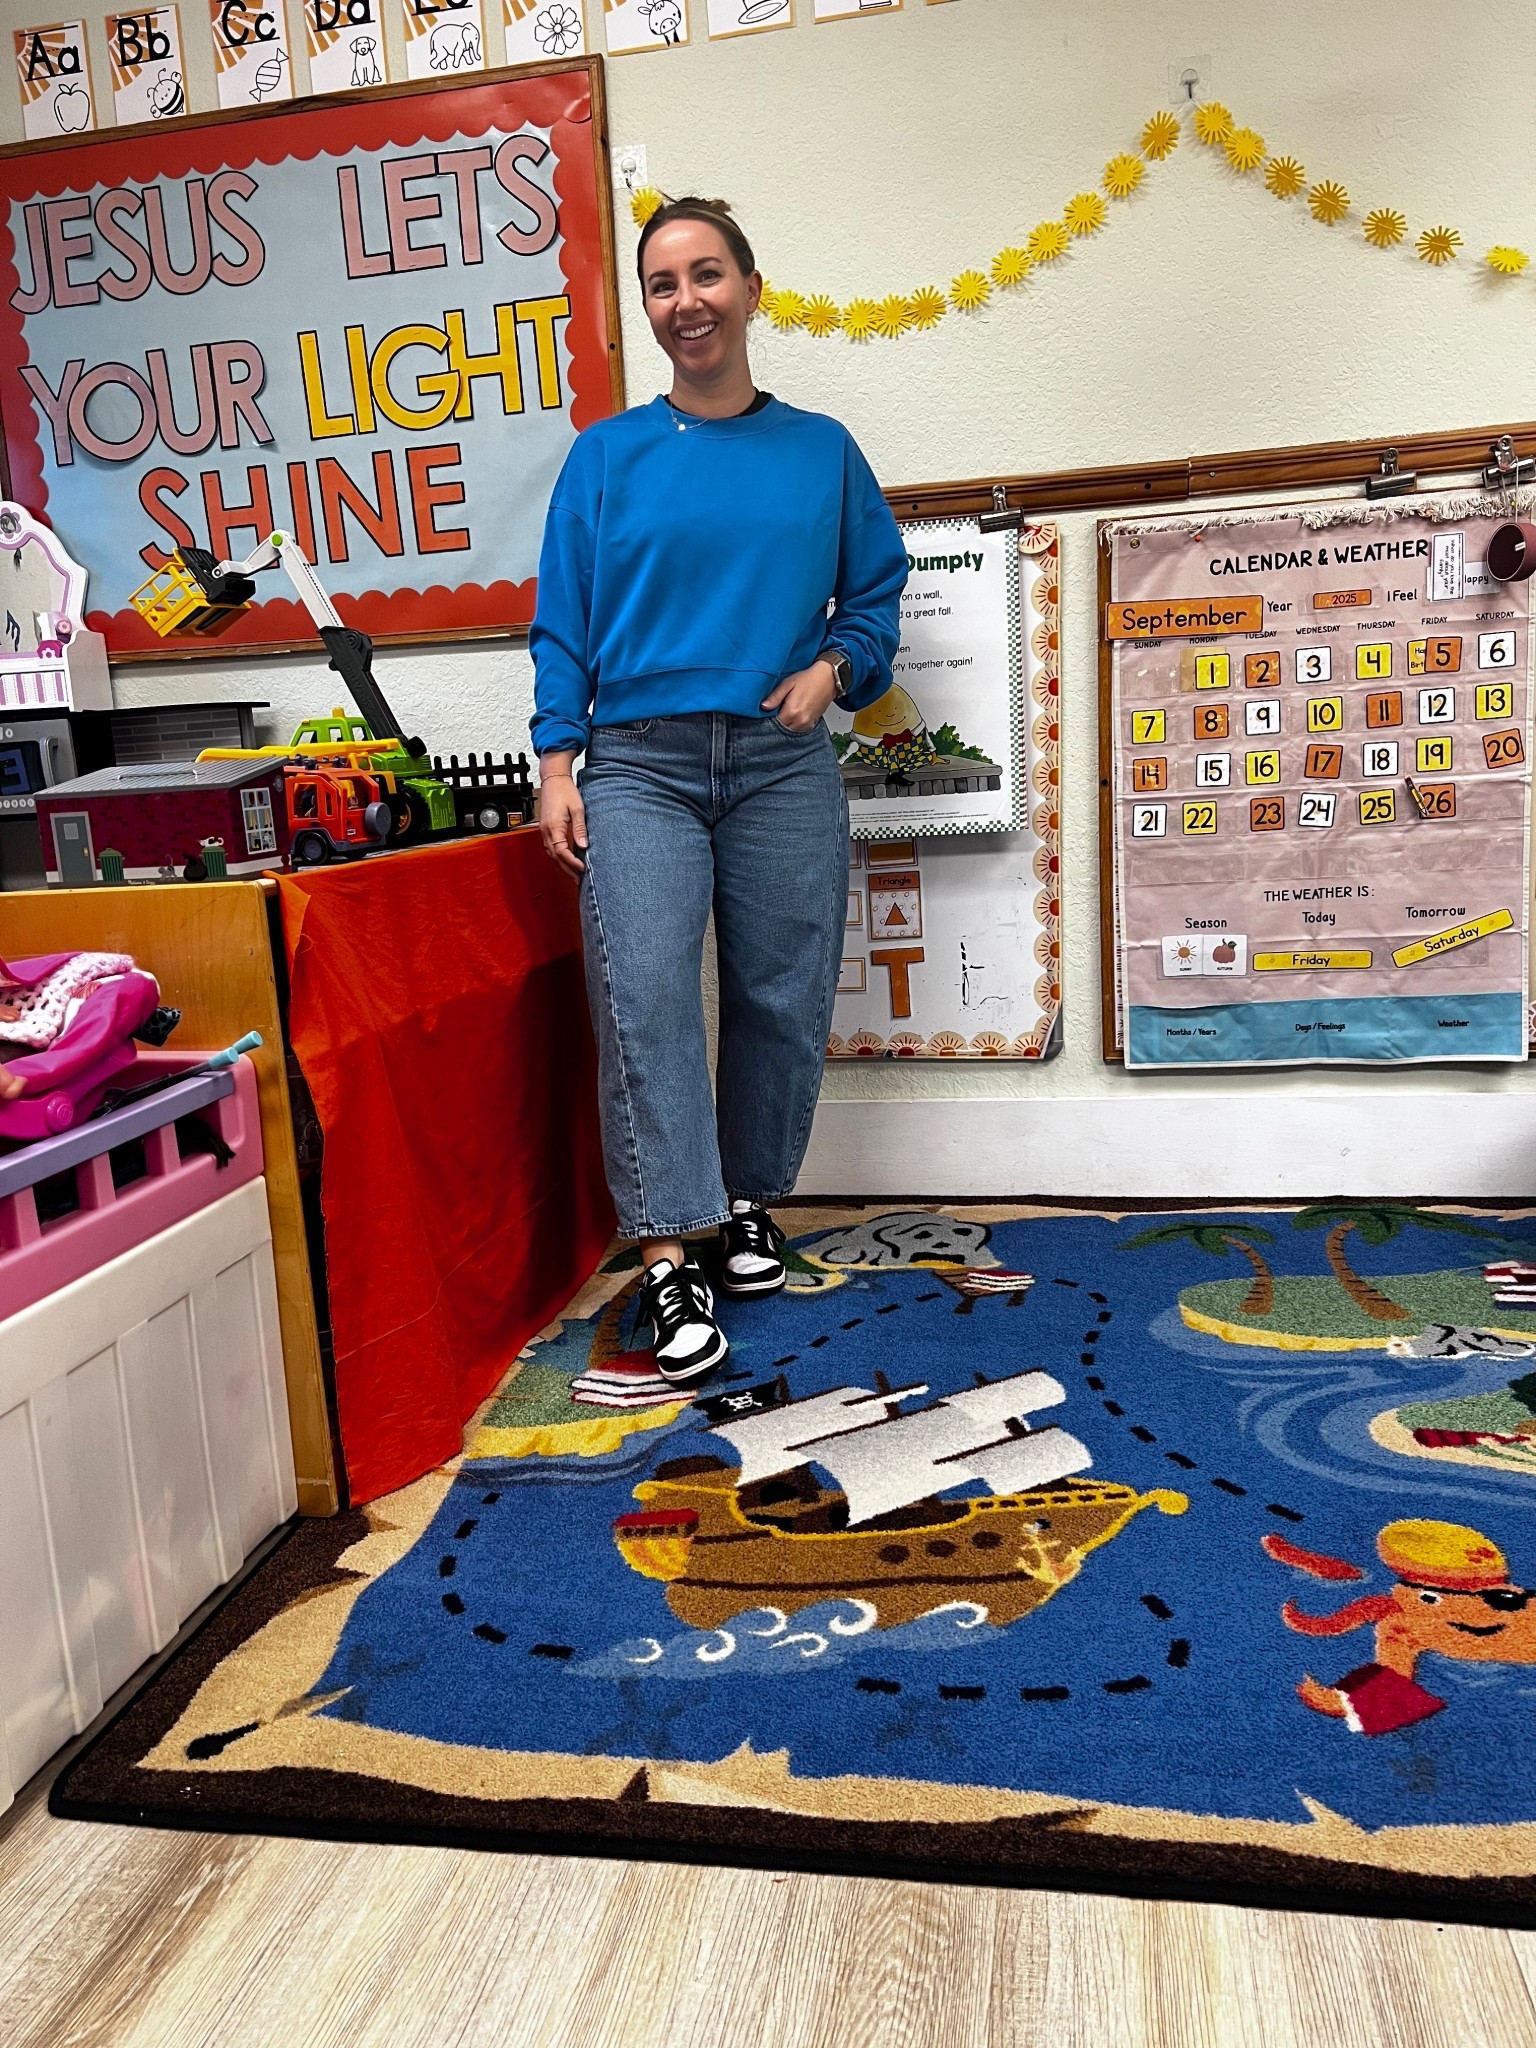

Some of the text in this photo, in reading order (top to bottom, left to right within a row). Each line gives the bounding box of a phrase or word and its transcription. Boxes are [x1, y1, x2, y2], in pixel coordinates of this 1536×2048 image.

[222, 0, 277, 46] Cc
[117, 14, 170, 66] Bb
[28, 33, 80, 80] Aa
[10, 134, 558, 314] JESUS LETS
[18, 296, 571, 467] YOUR LIGHT
[138, 443, 471, 572] SHINE
[1210, 539, 1428, 575] CALENDAR & WEATHER
[902, 593, 913, 601] on
[1267, 601, 1292, 612] Year
[1333, 593, 1356, 604] 2025
[1393, 589, 1417, 601] Feel
[914, 608, 936, 619] great
[1123, 604, 1248, 634] September
[1134, 641, 1162, 649] SUNDAY
[1189, 635, 1218, 644] MONDAY
[1296, 625, 1340, 634] WEDNESDAY
[1358, 621, 1395, 630] THURSDAY
[1422, 617, 1447, 625] FRIDAY
[1476, 612, 1514, 620] SATURDAY
[908, 658, 944, 671] together
[946, 657, 973, 669] again!
[1256, 660, 1270, 682] 2
[1307, 655, 1321, 678] 3
[1367, 651, 1380, 672] 4
[1436, 643, 1451, 666] 5
[1490, 639, 1505, 662] 6
[1142, 689, 1505, 738] 7 8 9 10 11 12 13
[1142, 737, 1520, 786] 14 15 16 17 18 19 20
[1141, 790, 1452, 831] 21 22 23 24 25 26
[877, 876, 912, 885] Triangle
[1264, 890, 1289, 902] THE
[1293, 887, 1352, 900] WEATHER
[1184, 917, 1228, 929] Season
[1302, 912, 1335, 925] Today
[1406, 907, 1465, 918] Tomorrow
[1424, 926, 1480, 952] Saturday
[1293, 954, 1330, 967] Friday
[870, 947, 925, 1018] T
[1166, 1028, 1192, 1036] Months
[1296, 1024, 1311, 1032] Days
[1318, 1023, 1345, 1032] Feelings
[1438, 1019, 1470, 1028] Weather
